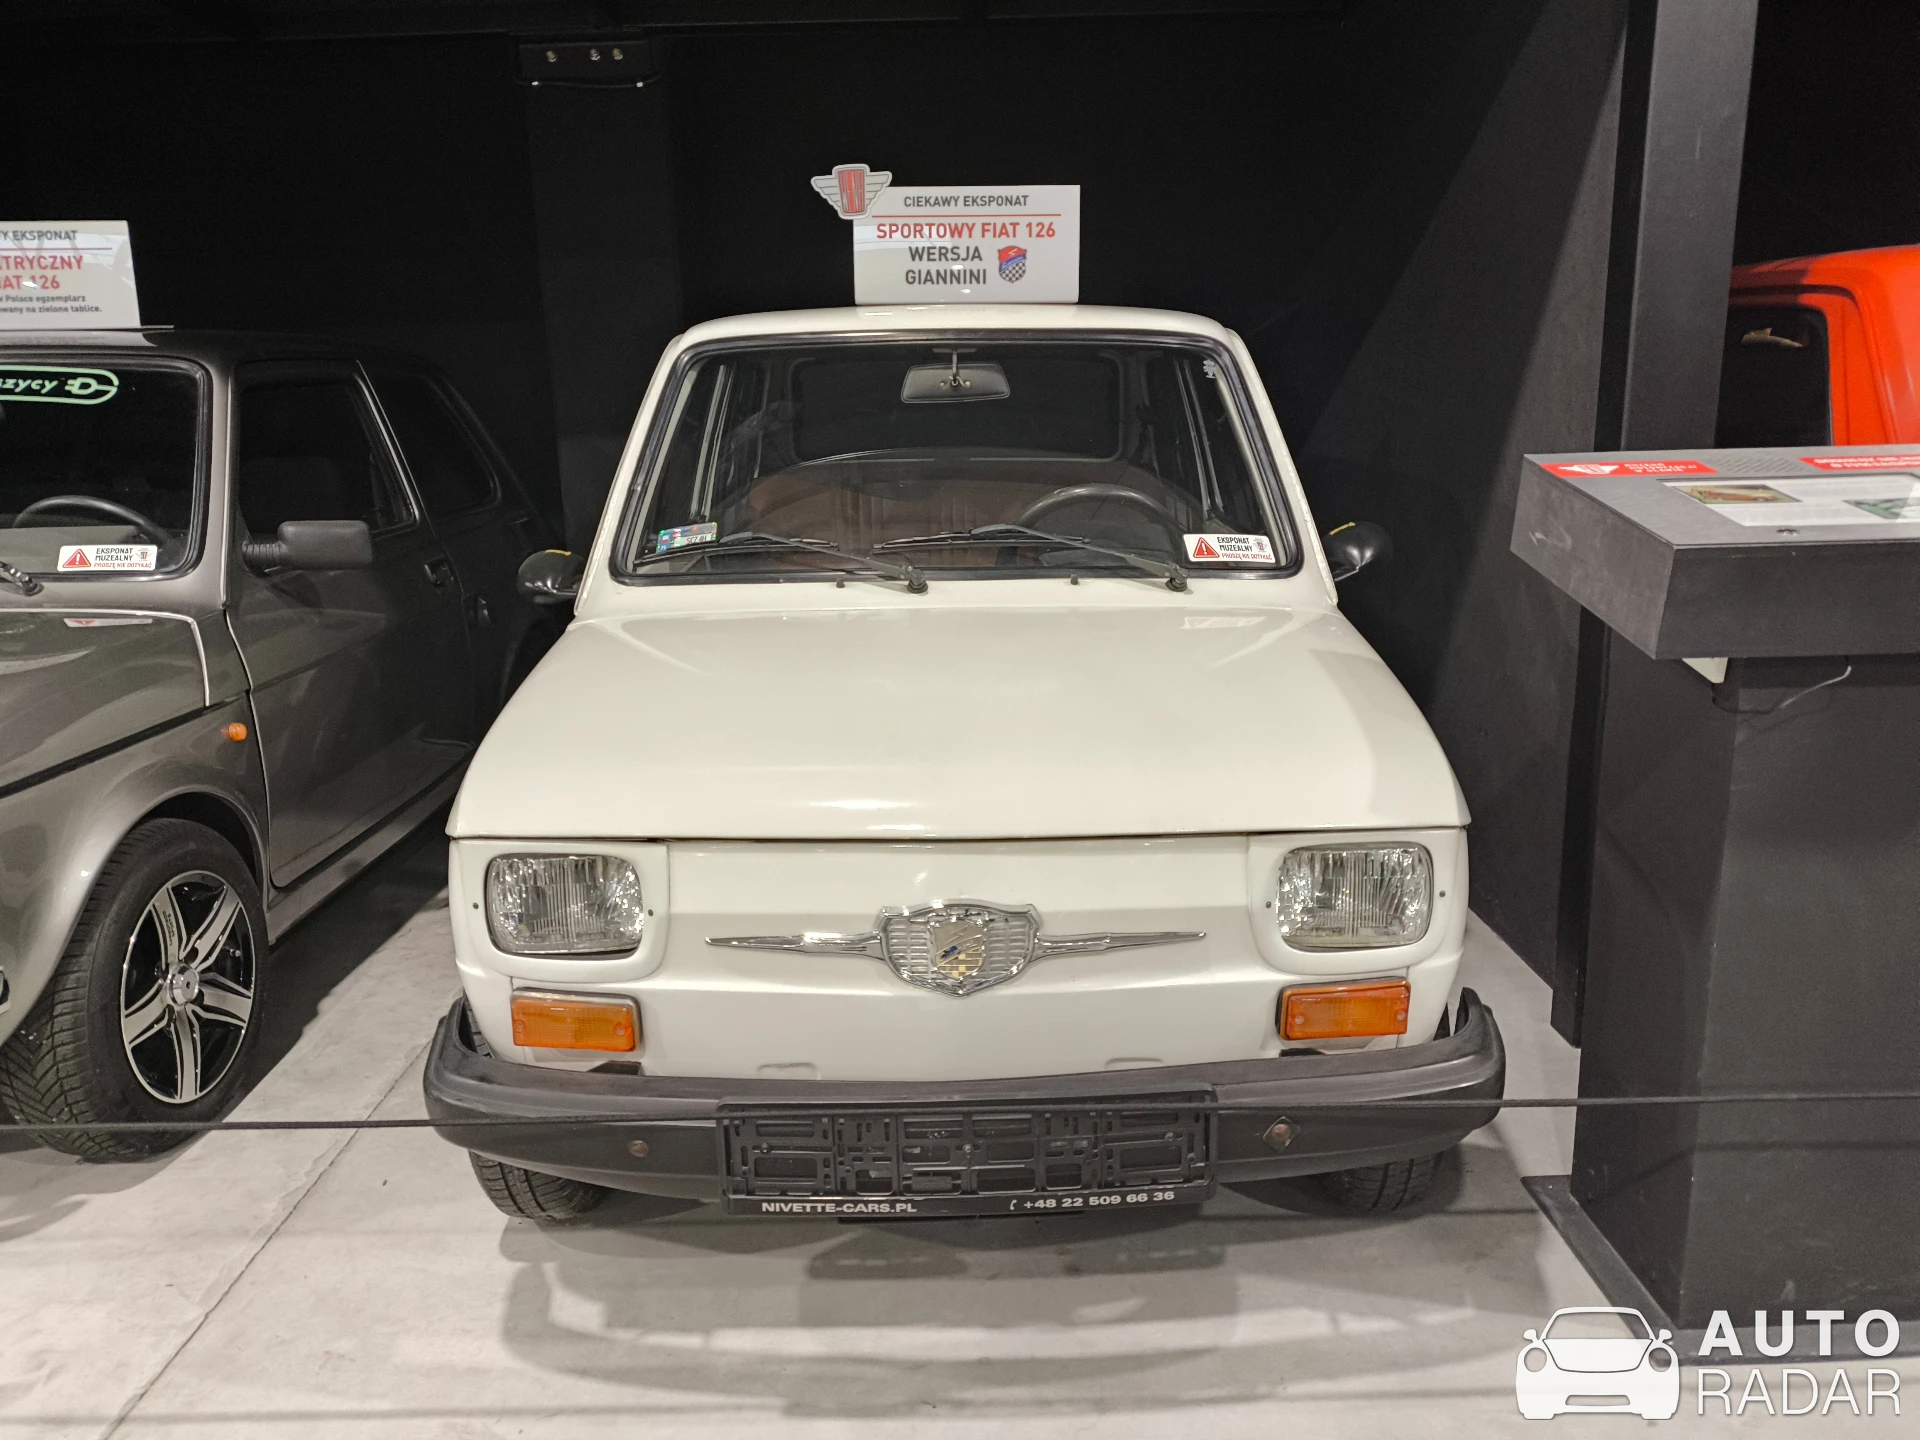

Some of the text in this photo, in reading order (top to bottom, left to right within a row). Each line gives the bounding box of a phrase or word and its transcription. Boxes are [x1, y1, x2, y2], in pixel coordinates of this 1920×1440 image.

[904, 195, 1029, 207] CIEKAWY EKSPONAT
[12, 230, 78, 241] EKSPONAT
[876, 222, 1056, 239] SPORTOWY FIAT 126
[909, 246, 983, 262] WERSJA
[0, 255, 83, 270] TRYCZNY
[905, 269, 987, 285] GIANNINI
[35, 294, 86, 304] egzemplarz
[38, 305, 69, 313] zielone
[1217, 537, 1250, 545] EKSPONAT
[761, 1191, 1175, 1213] NIVETTE-CARS.PL +48 22 509 66 36
